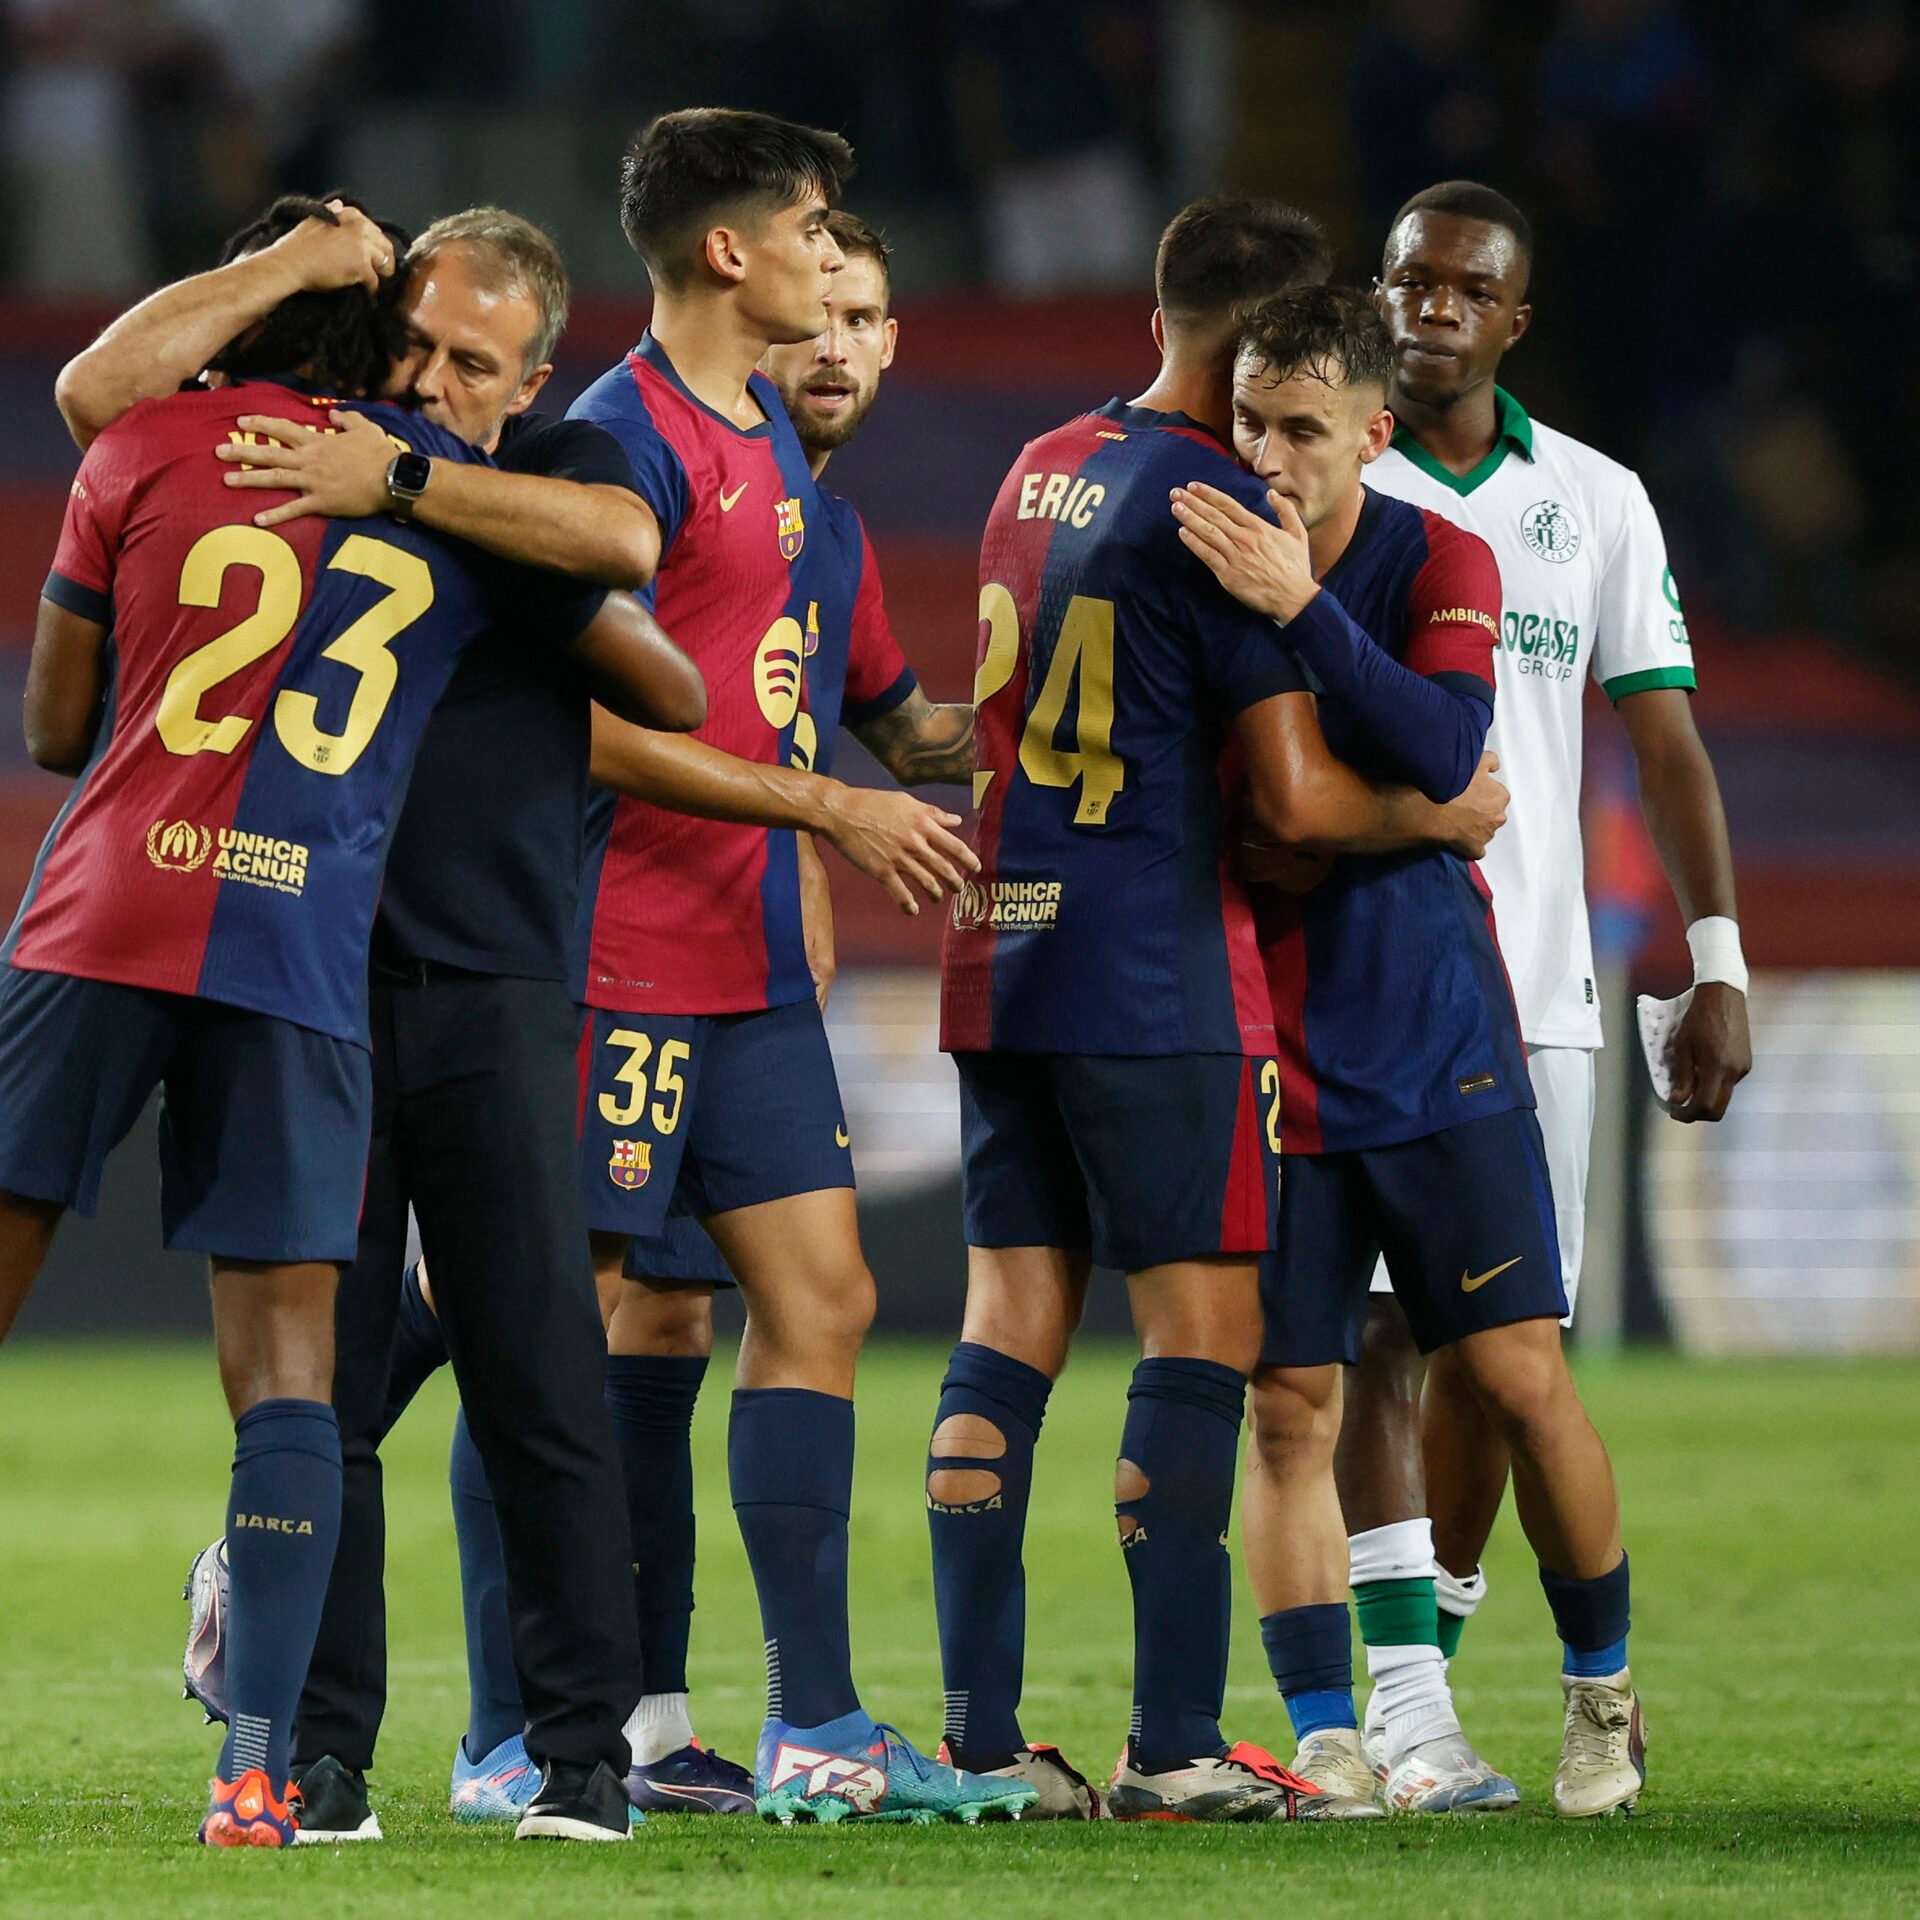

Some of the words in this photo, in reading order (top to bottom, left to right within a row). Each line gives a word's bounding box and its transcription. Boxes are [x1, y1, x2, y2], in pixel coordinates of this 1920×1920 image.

[1017, 472, 1106, 529] ERIC
[156, 525, 435, 776] 23
[1496, 611, 1579, 665] OCASA
[218, 827, 309, 867] UNHCR
[212, 849, 306, 887] ACNUR
[212, 869, 227, 879] The
[228, 871, 240, 882] UN
[988, 901, 1058, 922] ACNUR
[990, 882, 1062, 902] UNHCR
[598, 1028, 690, 1135] 35
